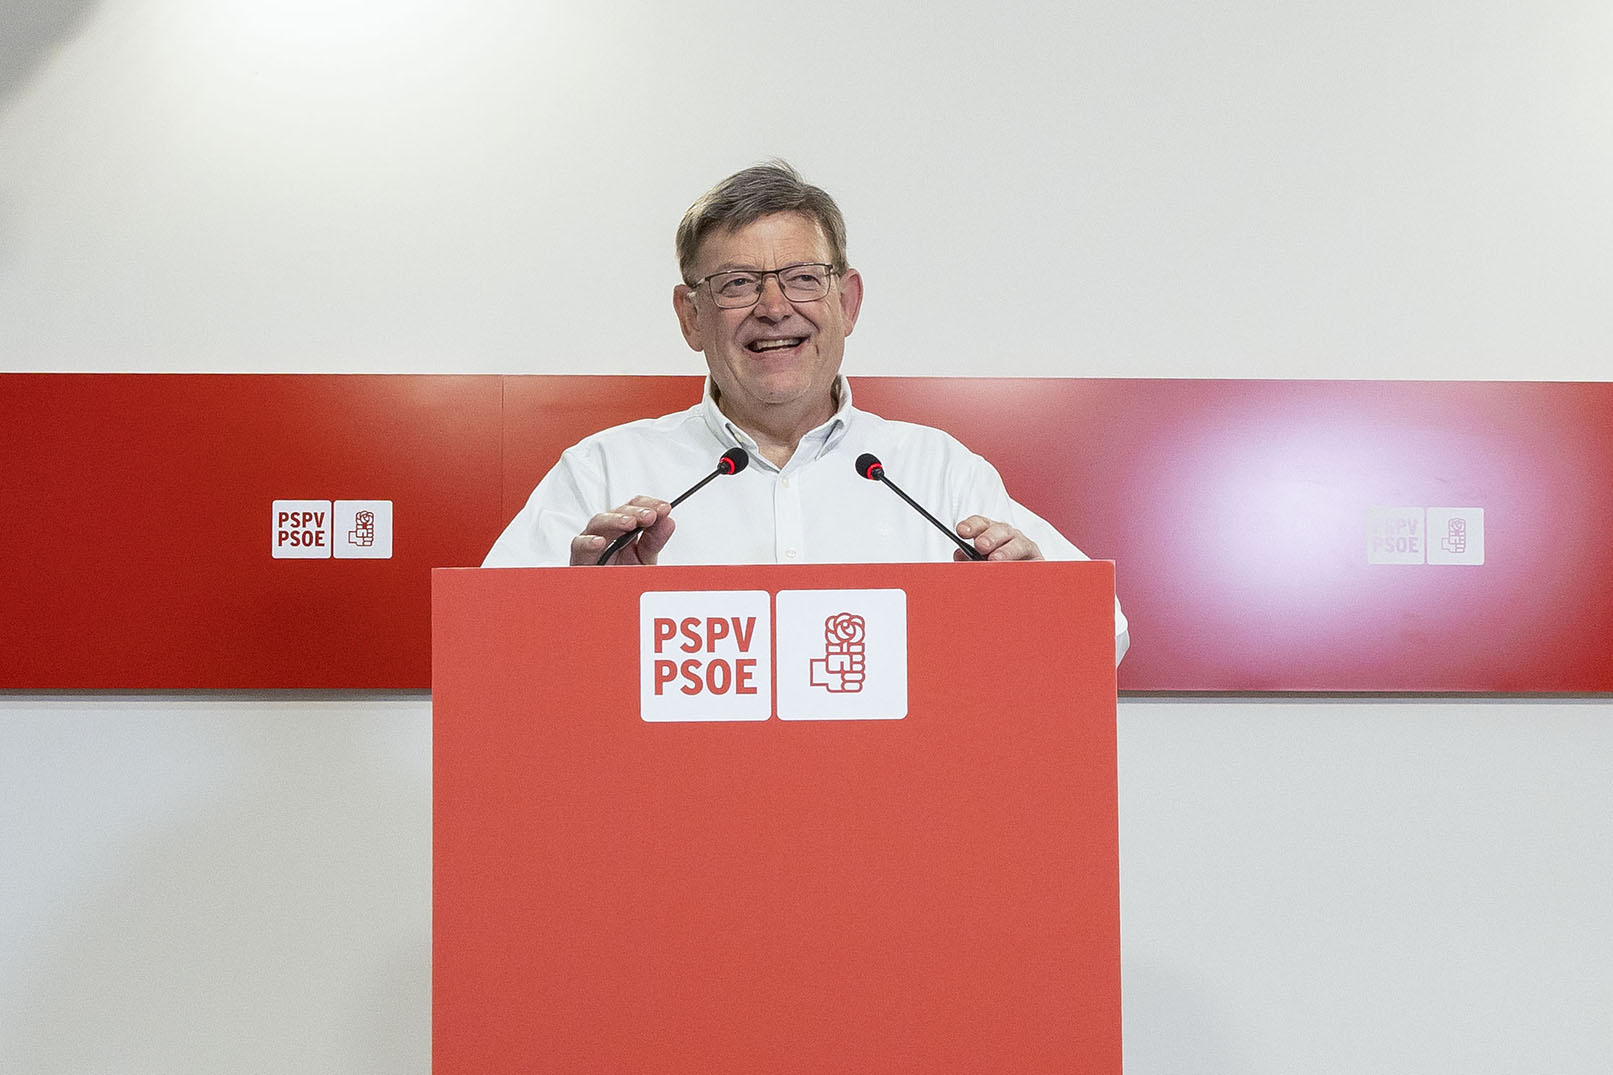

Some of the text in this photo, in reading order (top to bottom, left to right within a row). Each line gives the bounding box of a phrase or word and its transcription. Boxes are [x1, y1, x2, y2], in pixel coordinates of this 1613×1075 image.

[278, 511, 325, 528] PSPV
[1373, 518, 1419, 535] SPV
[278, 530, 325, 547] PSOE
[1373, 536, 1419, 553] PSOE
[653, 616, 757, 654] PSPV
[653, 658, 758, 696] PSOE
